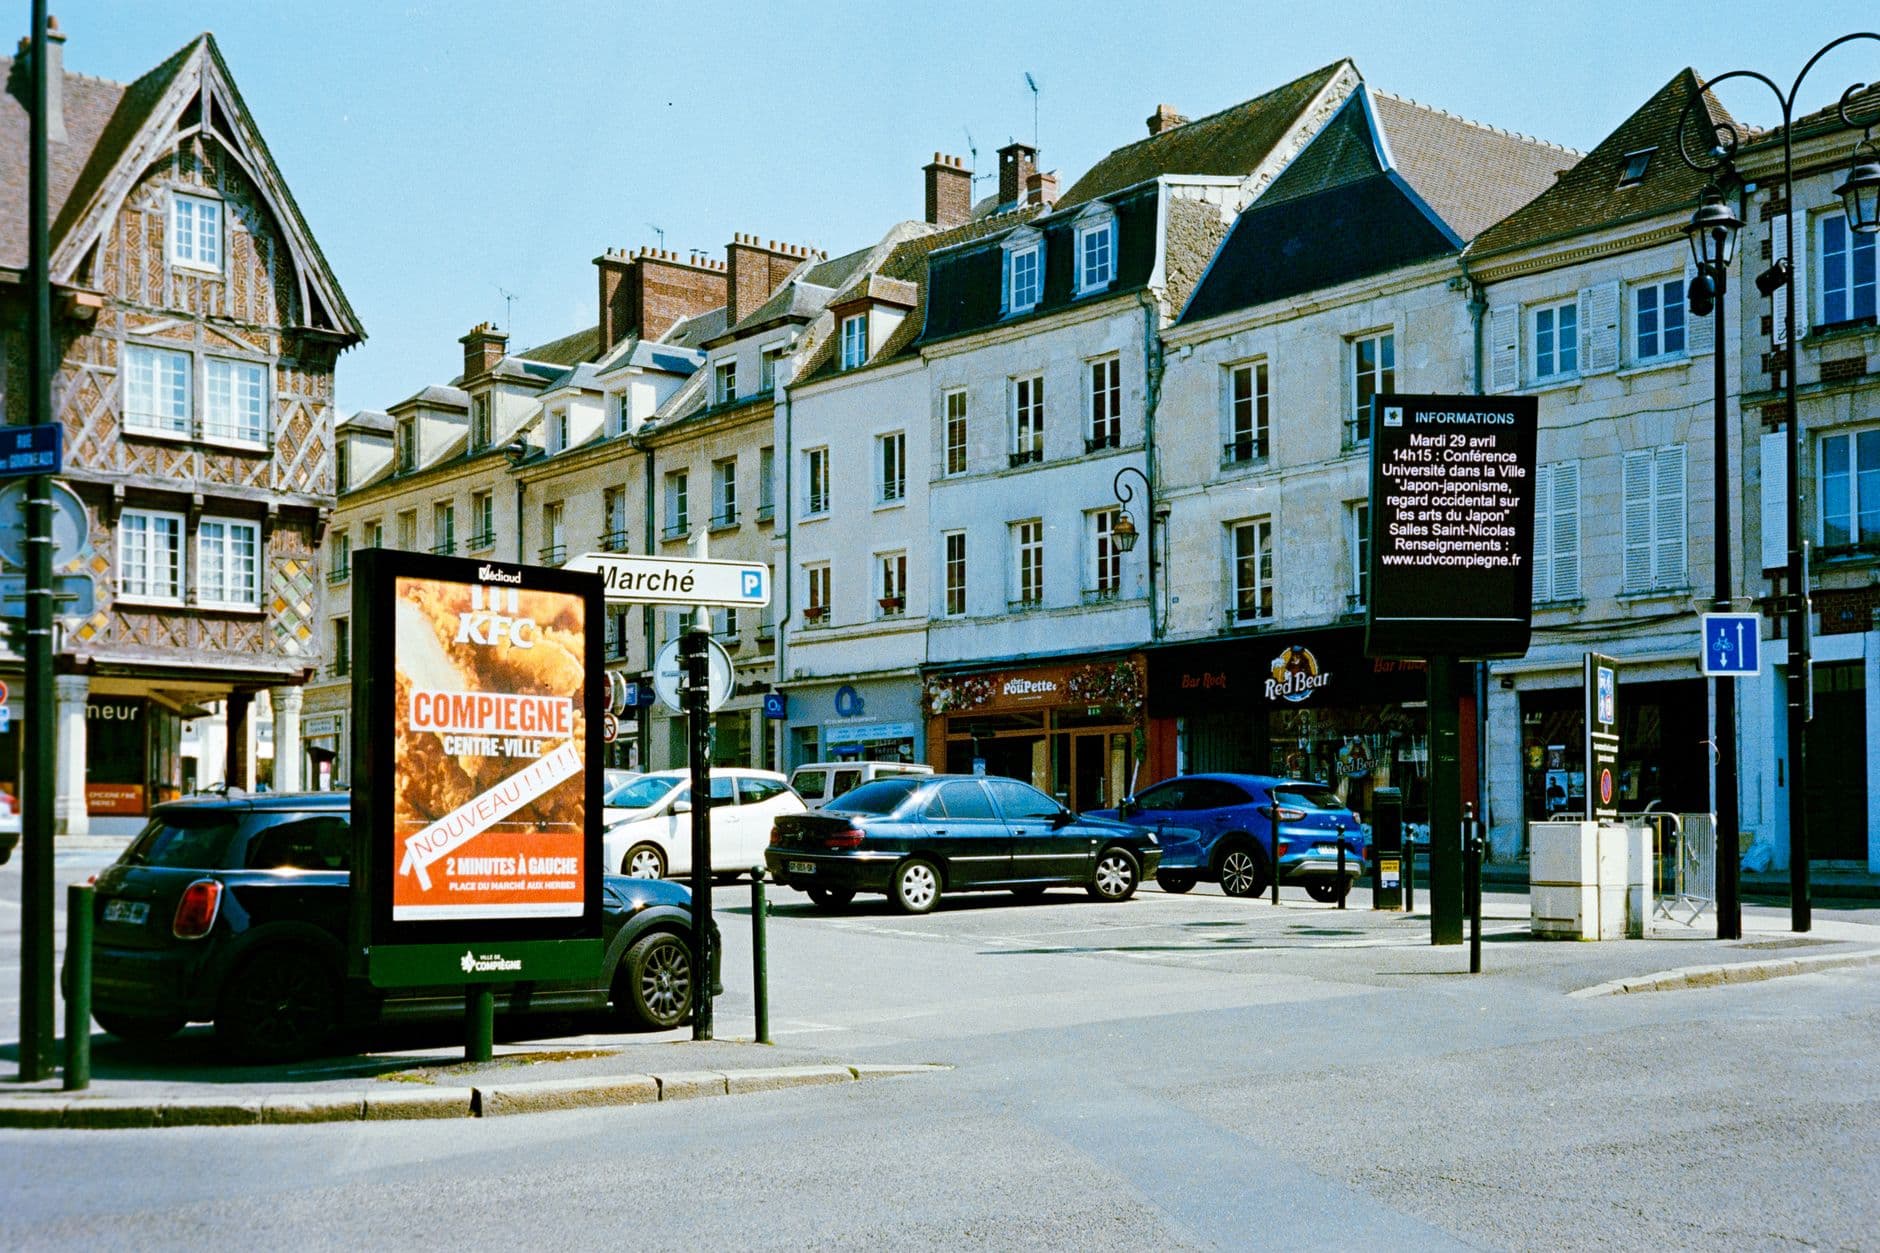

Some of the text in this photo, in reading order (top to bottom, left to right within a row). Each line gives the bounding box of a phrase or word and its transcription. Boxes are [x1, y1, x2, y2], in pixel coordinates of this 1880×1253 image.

[1415, 411, 1515, 425] INFORMATIONS
[1410, 434, 1496, 448] Mardi 29 avril
[1393, 449, 1432, 461] 14h15
[1443, 450, 1517, 463] Conférence
[1382, 464, 1526, 478] Université dans la Ville
[1395, 478, 1512, 494] "Japon-japonisme,
[1386, 494, 1520, 509] regard occidental sur
[1396, 508, 1510, 524] les arts du Japon"
[1389, 523, 1516, 537] Salles Saint-Nicolas
[1394, 538, 1501, 553] Renseignements
[1382, 554, 1522, 568] www.udvcompiegne.fr
[597, 565, 695, 593] Marché
[453, 611, 536, 649] KFC
[1182, 673, 1201, 689] Bar
[1264, 671, 1330, 700] Red Bear
[414, 692, 569, 733] COMPIEGNE
[444, 735, 542, 758] CENTRE-VILLE
[413, 781, 521, 859] NOUVEAU
[446, 853, 578, 876] 2 MINUTES À GAUCHE
[448, 881, 476, 891] PLACE
[477, 881, 490, 891] DU
[491, 879, 526, 891] MARCHÉ
[527, 881, 544, 890] AUX
